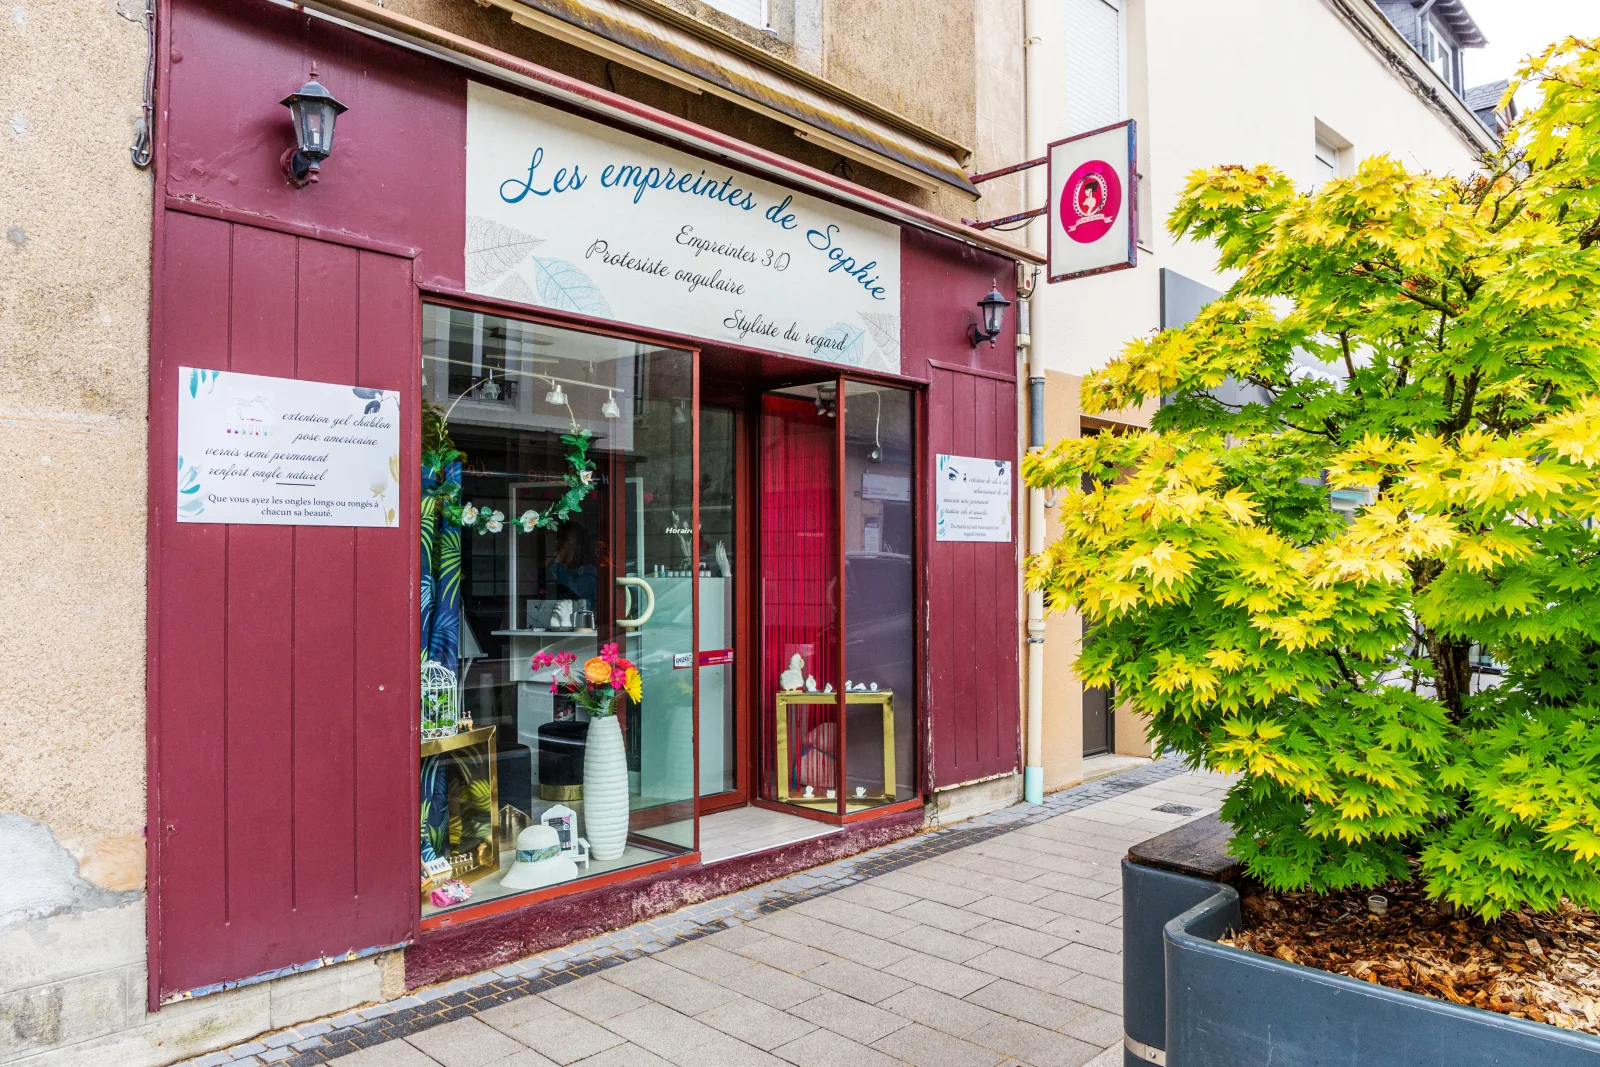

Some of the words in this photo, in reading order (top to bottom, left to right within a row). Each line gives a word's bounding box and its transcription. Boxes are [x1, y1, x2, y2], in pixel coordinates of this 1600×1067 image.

[499, 147, 588, 204] Les
[600, 163, 757, 211] empreintes
[765, 196, 798, 231] de
[806, 224, 886, 301] Sophie
[675, 224, 757, 265] Empreintes
[761, 248, 791, 272] 3D
[585, 238, 670, 277] Protesiste
[674, 266, 746, 296] ongulaire
[723, 309, 780, 339] Styliste
[783, 325, 802, 343] du
[804, 332, 848, 353] regard
[282, 413, 330, 425] extention
[331, 415, 351, 429] gel
[352, 416, 392, 430] chablon
[292, 432, 321, 445] pose
[323, 435, 379, 446] americaine
[205, 447, 242, 458] vernis
[244, 449, 269, 459] semi
[268, 451, 329, 464] permanent
[208, 464, 249, 481] renfort
[252, 467, 284, 484] ongle
[286, 469, 327, 481] naturel
[208, 493, 228, 504] Que
[229, 496, 250, 504] vous
[251, 497, 270, 507] ayez
[272, 495, 284, 505] les
[284, 496, 312, 508] ongles
[313, 497, 335, 508] longs
[336, 500, 347, 508] ou
[348, 499, 373, 511] rongés
[373, 499, 379, 508] à
[261, 507, 292, 516] chacun
[293, 509, 303, 517] sa
[304, 508, 333, 517] beauté.
